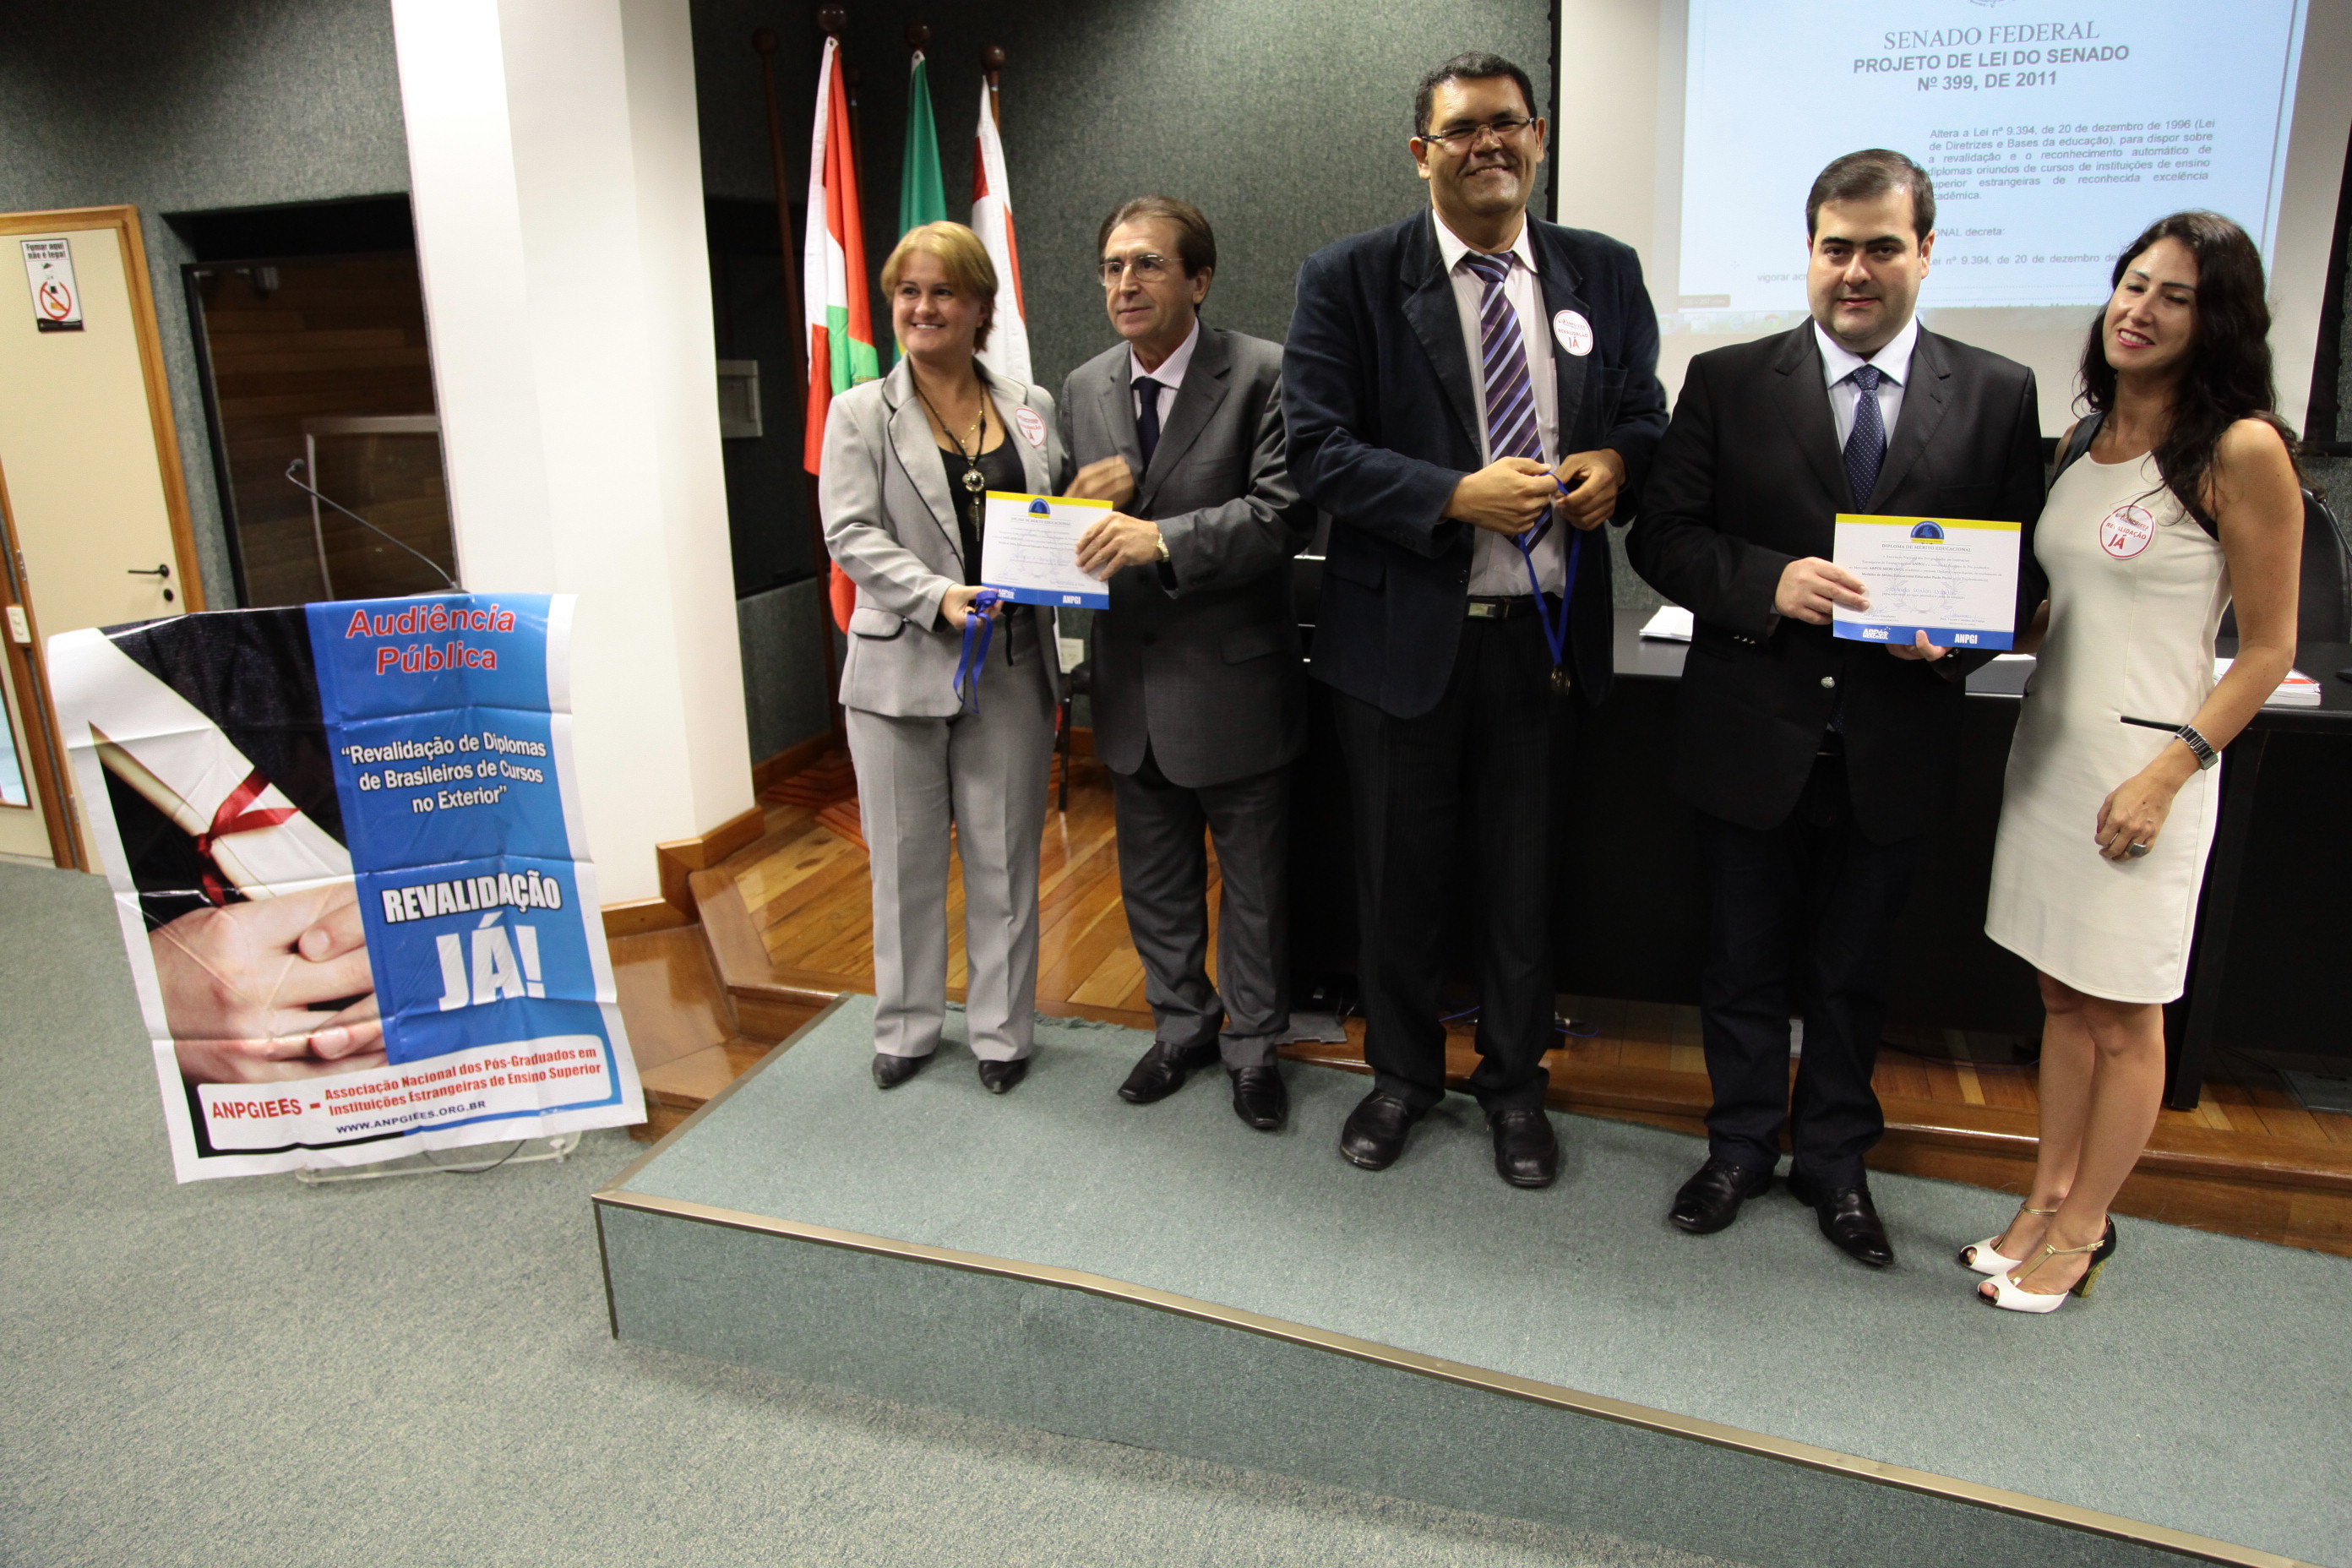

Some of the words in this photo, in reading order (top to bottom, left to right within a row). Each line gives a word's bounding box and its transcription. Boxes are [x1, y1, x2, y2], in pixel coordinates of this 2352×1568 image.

[1884, 27, 1982, 50] SENADO
[1988, 20, 2100, 44] FEDERAL
[1854, 55, 1941, 74] PROJETO
[1946, 53, 1973, 68] DE
[1978, 52, 2007, 68] LEI
[2012, 50, 2041, 66] DO
[2046, 45, 2130, 63] SENADO
[1917, 76, 1937, 91] Nº
[1942, 74, 1978, 91] 399,
[1984, 73, 2011, 88] DE
[2015, 70, 2056, 87] 2011
[1930, 129, 1959, 139] Altera
[1974, 128, 1989, 137] Lei
[2006, 126, 2038, 136] 9.394,
[2041, 125, 2055, 134] de
[2058, 124, 2072, 134] 20
[2075, 123, 2088, 133] de
[2092, 122, 2143, 133] dezembro
[2148, 121, 2161, 130] de
[2165, 119, 2191, 129] 1996
[2194, 118, 2216, 130] (Lei
[1929, 142, 1942, 151] de
[1946, 140, 1994, 151] Diretrizes
[1996, 140, 2003, 149] e
[2007, 139, 2039, 149] Bases
[2042, 138, 2055, 147] da
[2120, 134, 2143, 146] para
[2148, 133, 2180, 145] dispor
[2183, 132, 2213, 143] sobre
[1943, 152, 2001, 164] revalidação
[2041, 149, 2123, 160] reconhecimento
[2132, 145, 2189, 156] automático
[2198, 145, 2212, 155] de
[1928, 166, 1973, 177] diplomas
[1976, 165, 2020, 174] oriundos
[2023, 164, 2037, 173] de
[2040, 163, 2074, 172] cursos
[2078, 162, 2092, 172] de
[2096, 160, 2153, 172] instituições
[2158, 160, 2171, 169] de
[2175, 159, 2210, 167] ensino
[1932, 178, 1967, 189] uperior
[1979, 177, 2041, 188] estrangeiras
[2053, 176, 2066, 185] de
[2078, 173, 2141, 184] reconhecida
[2153, 172, 2209, 182] excelência
[1934, 191, 1982, 201] cadêmica.
[1935, 228, 1962, 237] ONAL
[1965, 227, 2006, 237] decreta:
[26, 242, 47, 252] Fumar
[1997, 255, 2010, 264] de
[2015, 254, 2028, 264] 20
[2032, 253, 2045, 264] de
[2050, 253, 2099, 263] dezembro
[1757, 274, 1789, 283] vigorar
[2108, 533, 2127, 550] JÁ
[345, 603, 516, 639] Audiência
[1954, 633, 1978, 645] ANPGI
[376, 640, 498, 675] Pública
[458, 733, 480, 752] de
[482, 732, 547, 758] Diplomas
[358, 772, 381, 791] de
[384, 763, 474, 789] Brasileiros
[476, 759, 498, 778] de
[499, 760, 544, 783] Cursos
[412, 796, 434, 814] no
[381, 869, 563, 924] REVALIDAÇÃO
[435, 911, 546, 1012] JÁ!
[324, 1079, 399, 1101] Associação
[401, 1065, 456, 1087] Nacional
[459, 1062, 482, 1076] dos
[484, 1048, 576, 1072] Pós-Graduados
[578, 1048, 597, 1059] em
[329, 1092, 406, 1116] Instituições
[409, 1079, 487, 1102] Estrangeiras
[490, 1074, 505, 1087] de
[508, 1070, 547, 1086] Ensino
[548, 1064, 602, 1080] Superior
[212, 1098, 302, 1119] ANPGIEES
[335, 1099, 487, 1134] WWW.ANPGIEES.ORG.BR
